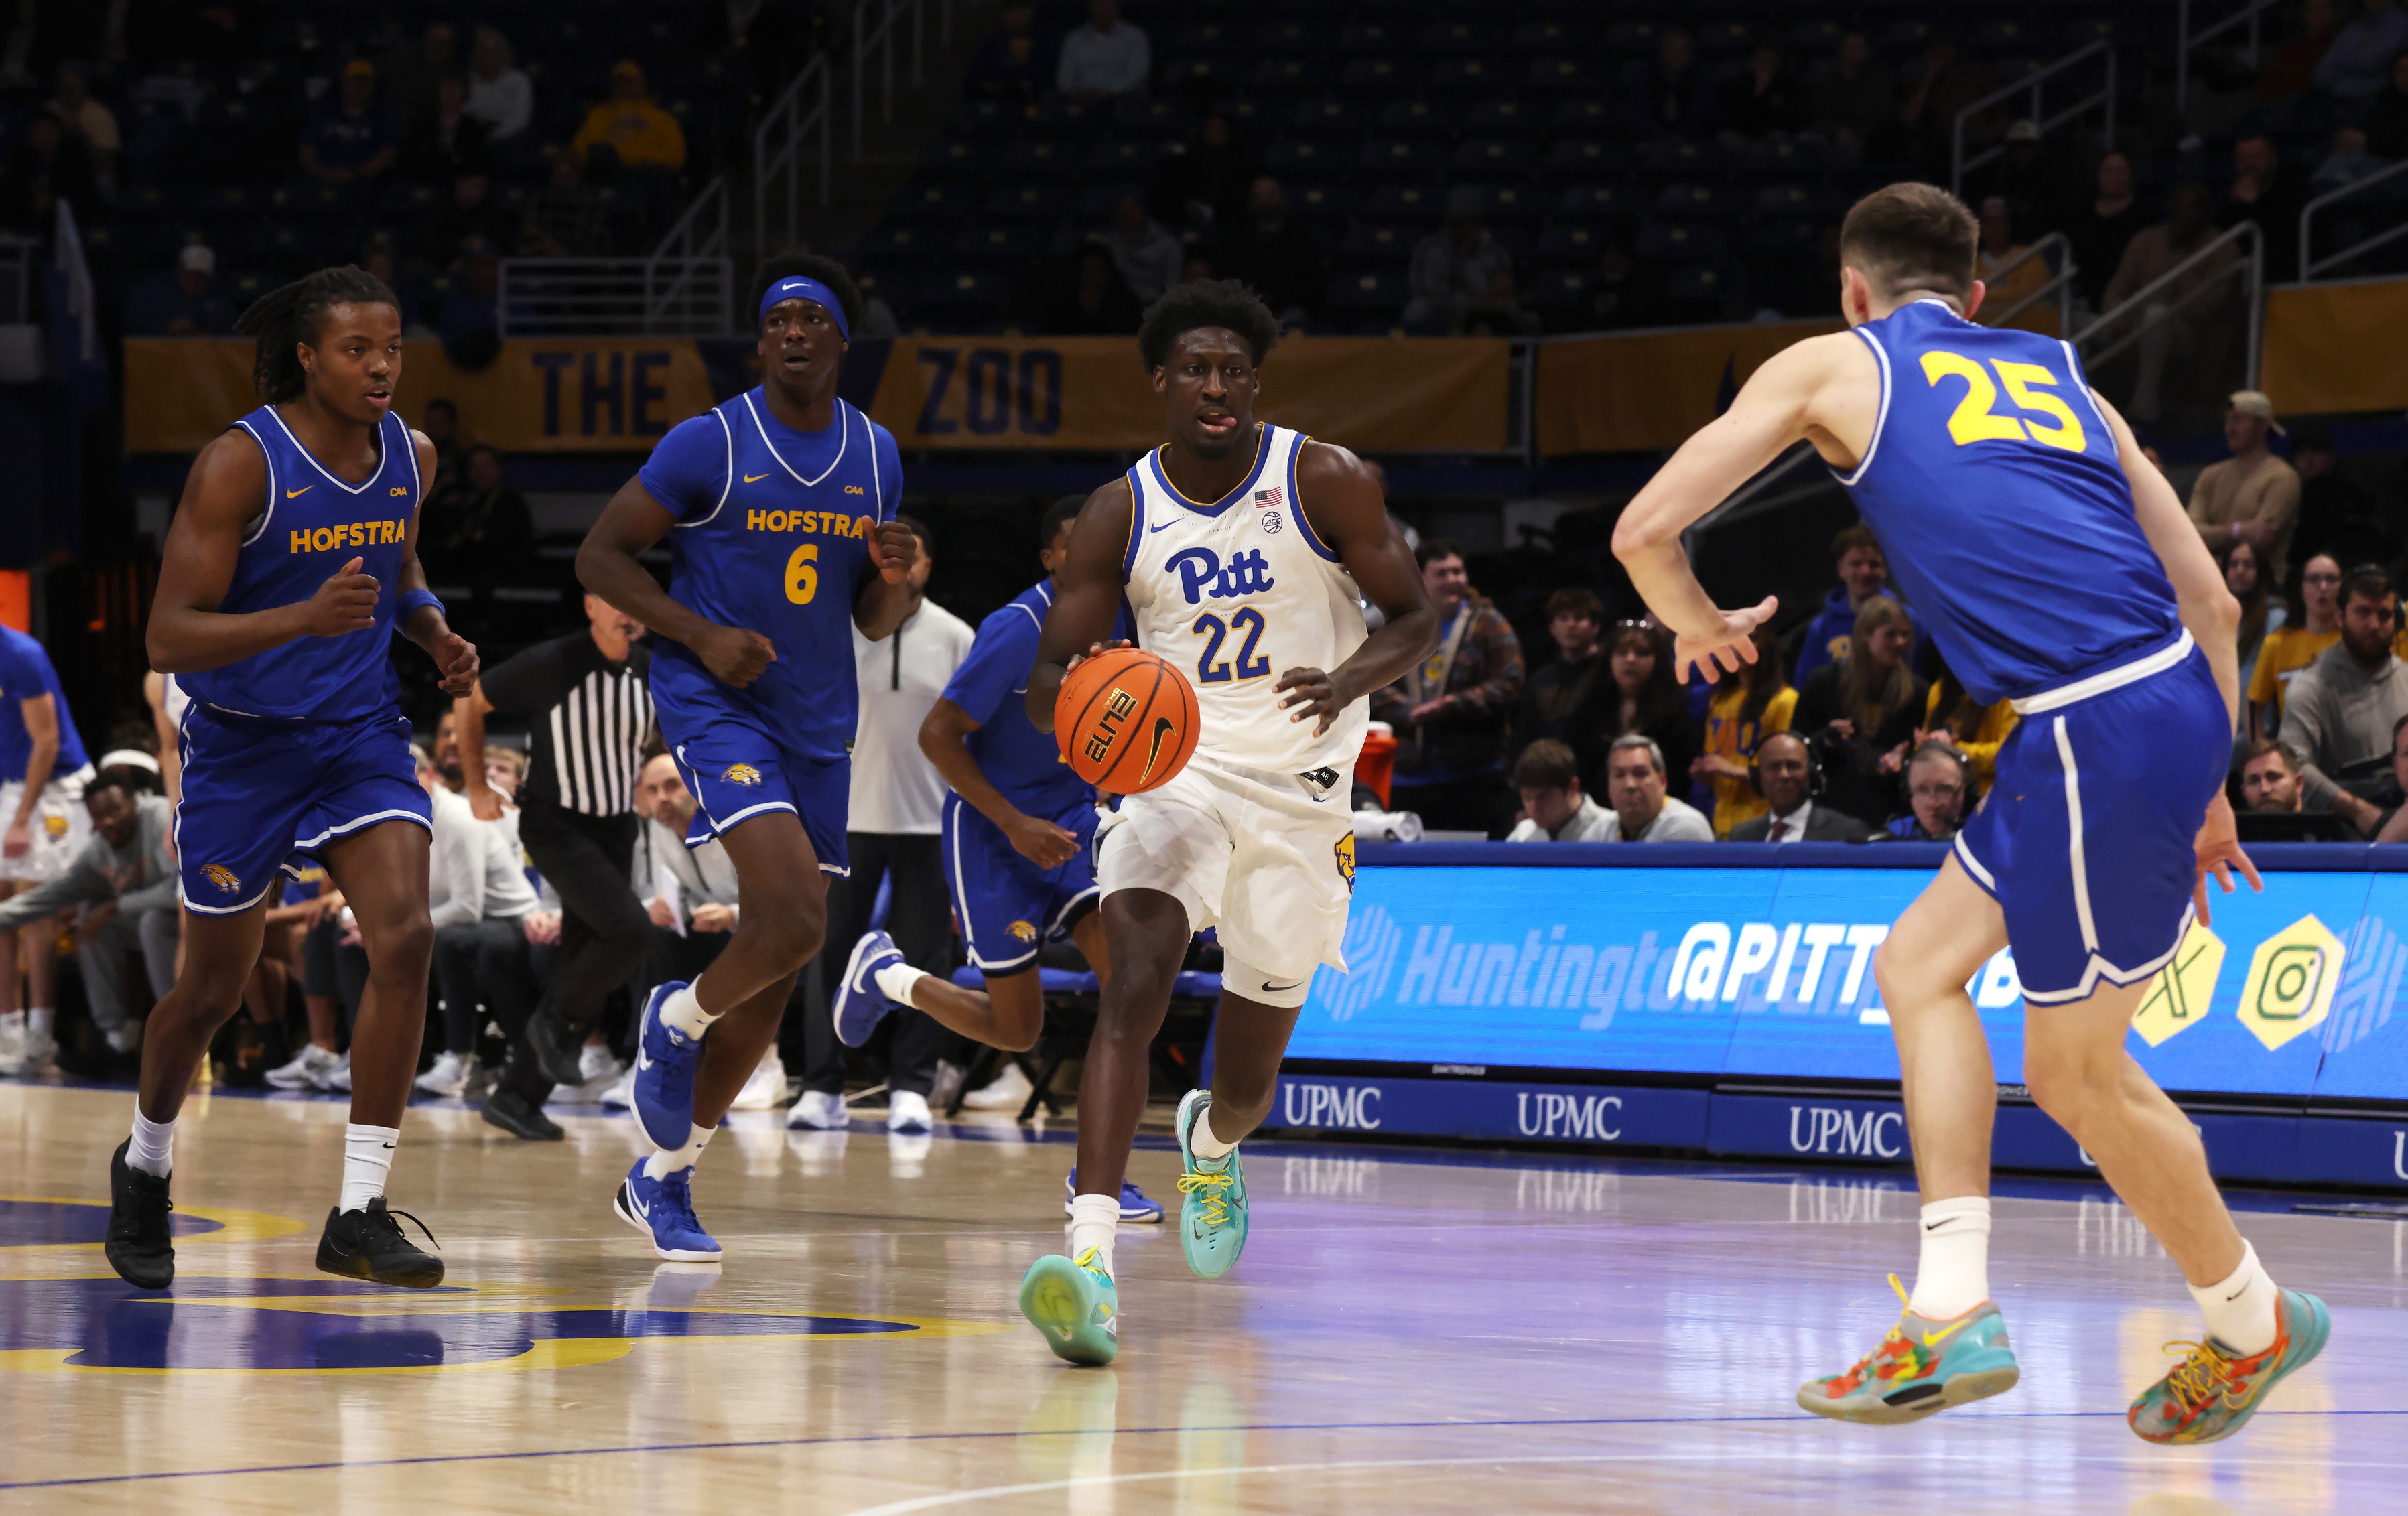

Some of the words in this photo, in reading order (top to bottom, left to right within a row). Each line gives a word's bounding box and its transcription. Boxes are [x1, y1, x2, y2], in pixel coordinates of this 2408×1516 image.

[532, 351, 670, 436] THE
[917, 348, 1063, 435] ZOO
[1919, 350, 2087, 453] 25
[389, 486, 407, 497] CAA
[844, 485, 864, 495] CAA
[291, 519, 405, 553] HOFSTRA
[746, 509, 864, 539] HOFSTRA
[784, 543, 819, 605] 6
[1164, 547, 1274, 604] Pitt
[1191, 605, 1272, 684] 22
[1084, 690, 1139, 764] ELITE
[1284, 1083, 1382, 1130] UPMC
[1517, 1092, 1622, 1140] UPMC
[1790, 1106, 1903, 1158] UPMC
